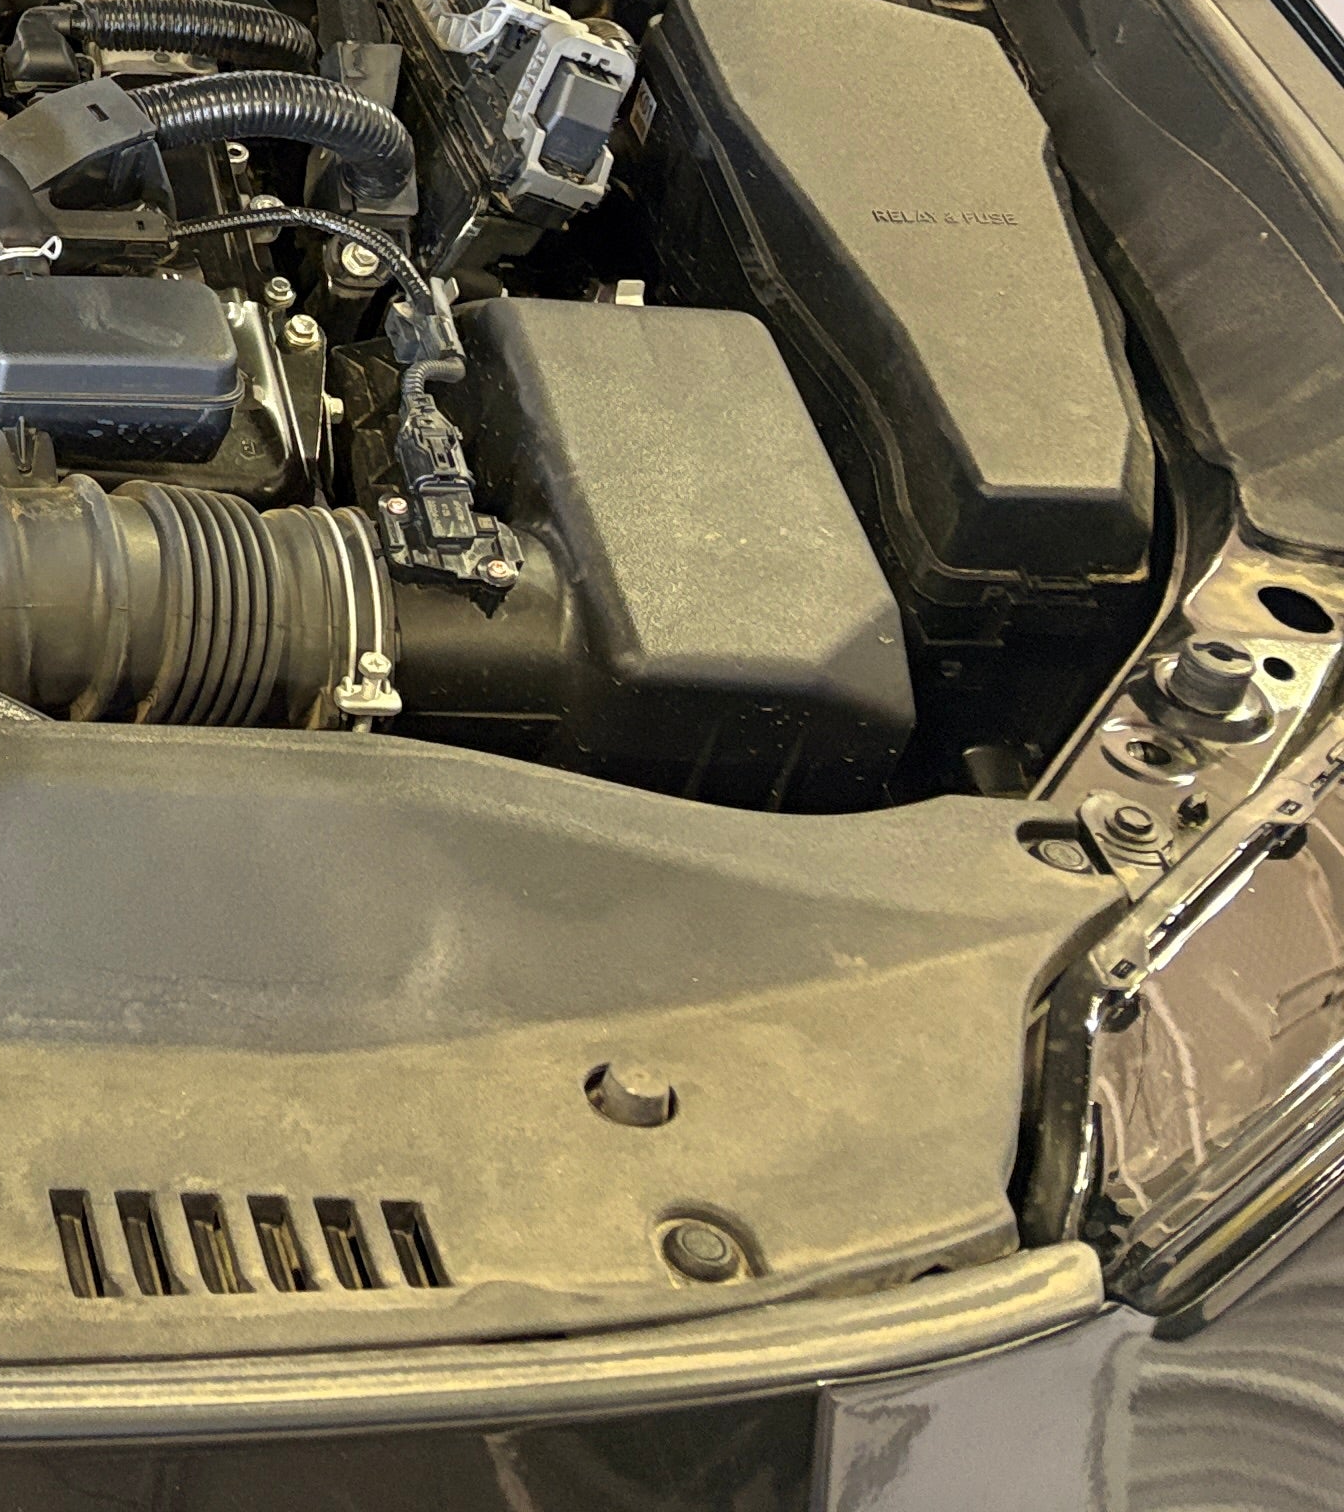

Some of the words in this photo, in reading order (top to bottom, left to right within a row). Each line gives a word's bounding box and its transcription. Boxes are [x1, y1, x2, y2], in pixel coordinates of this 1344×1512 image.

[871, 209, 938, 224] RELAY
[944, 213, 958, 225] &
[961, 212, 1019, 226] FUSE
